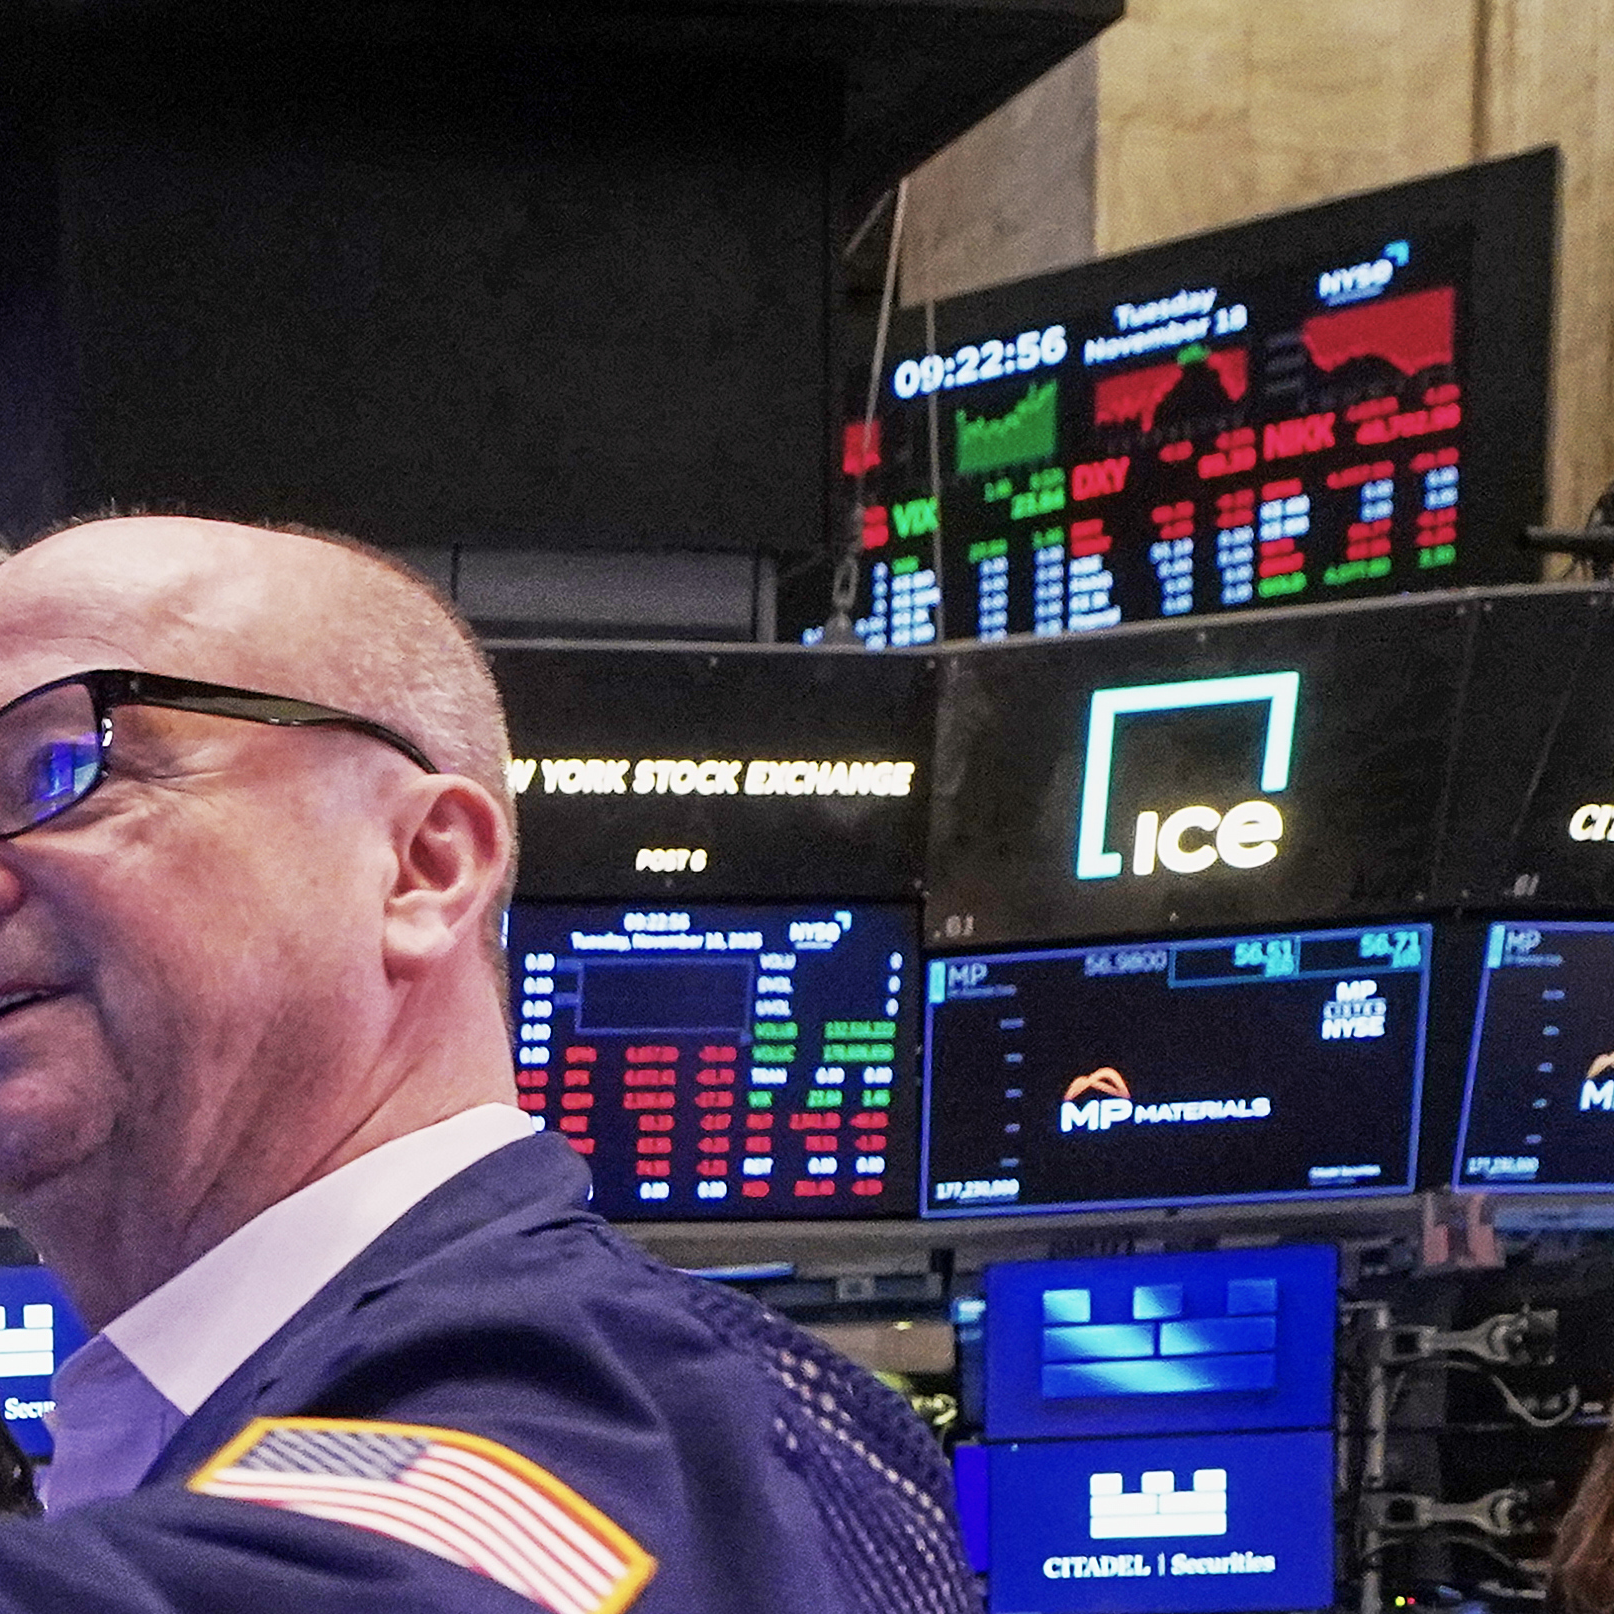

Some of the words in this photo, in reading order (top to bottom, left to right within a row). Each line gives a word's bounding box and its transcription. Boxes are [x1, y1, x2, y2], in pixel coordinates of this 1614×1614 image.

[1114, 286, 1218, 332] Tuesday
[1083, 316, 1212, 366] November
[893, 324, 1069, 400] 09:22:56
[540, 758, 631, 794] YORK
[631, 758, 743, 795] STOCK
[743, 760, 916, 796] EXCHANGE
[948, 962, 989, 987] MP
[1335, 979, 1378, 1002] MP
[1321, 1015, 1386, 1040] NYSE
[1579, 1078, 1614, 1113] M
[1060, 1098, 1134, 1133] MP
[1134, 1096, 1272, 1125] MATERIALS
[1042, 1554, 1152, 1579] CITADEL
[1170, 1550, 1276, 1577] Securities
